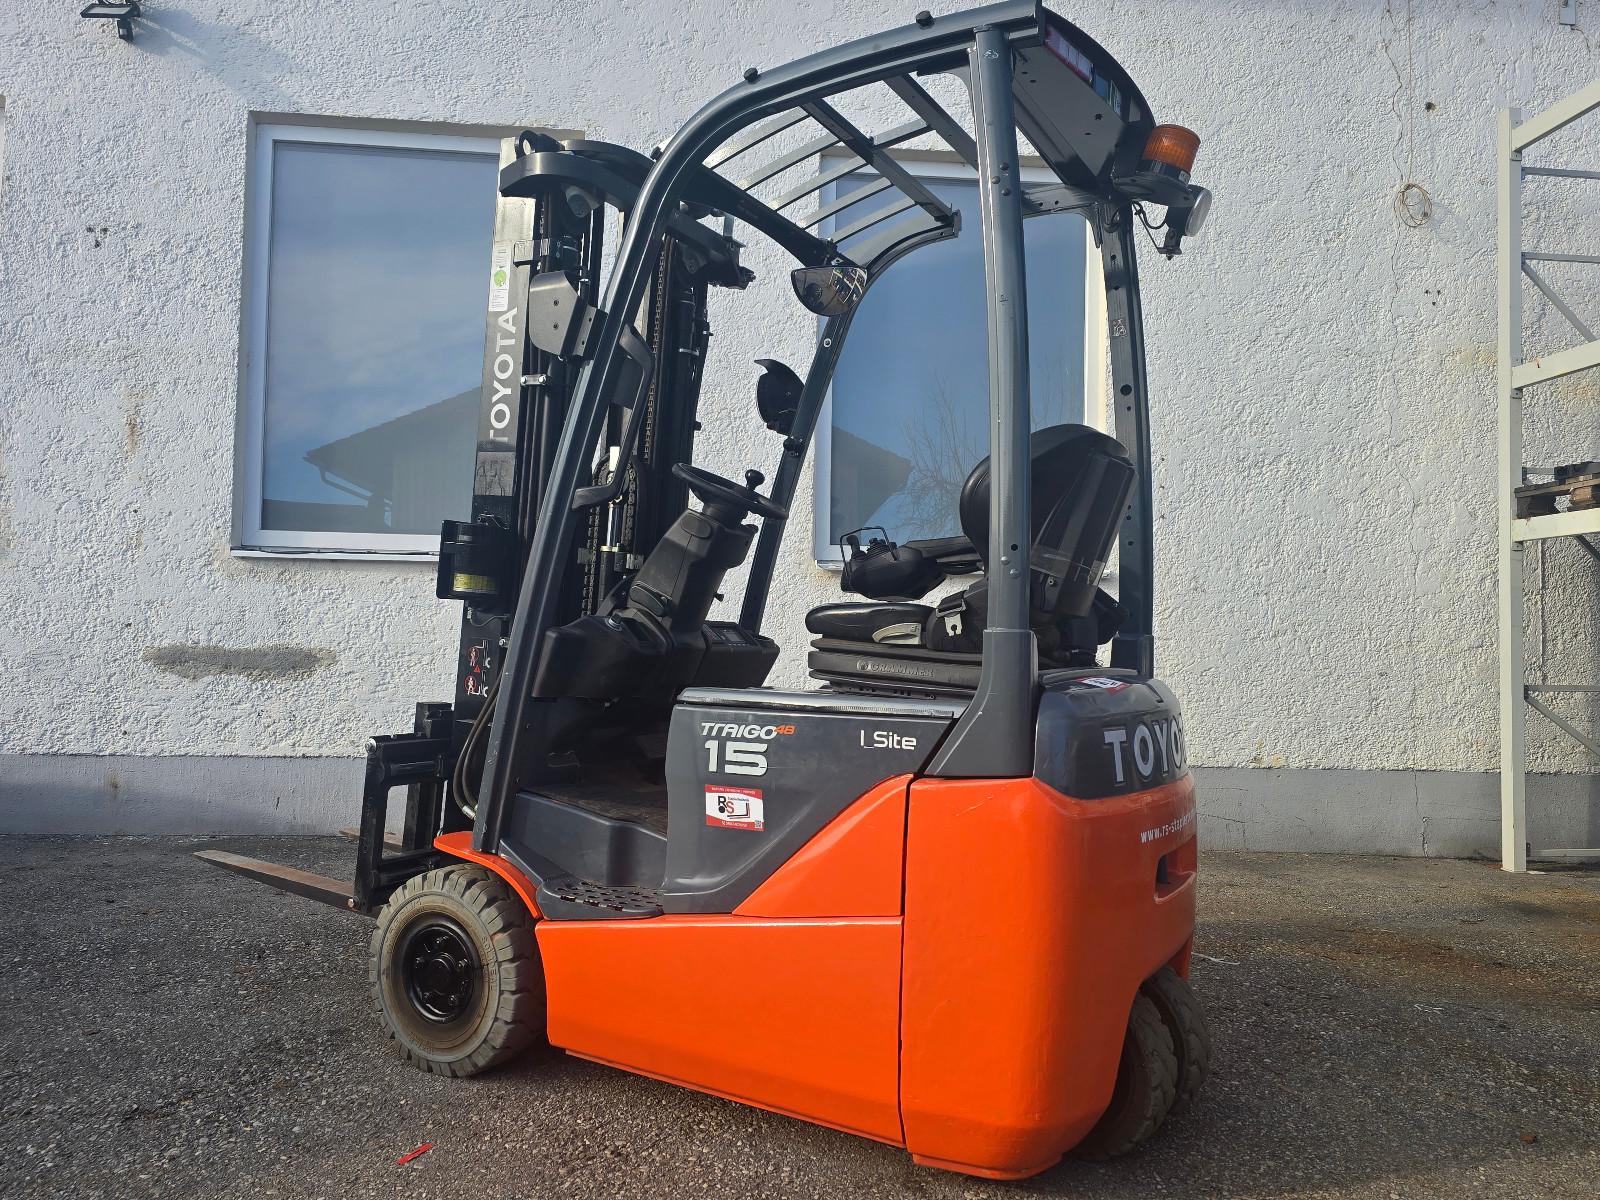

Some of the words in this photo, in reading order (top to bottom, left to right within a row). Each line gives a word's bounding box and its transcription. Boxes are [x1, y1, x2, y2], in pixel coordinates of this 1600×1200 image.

[489, 305, 518, 443] TOYOTA
[704, 739, 768, 776] 15
[1103, 716, 1187, 782] TOYO
